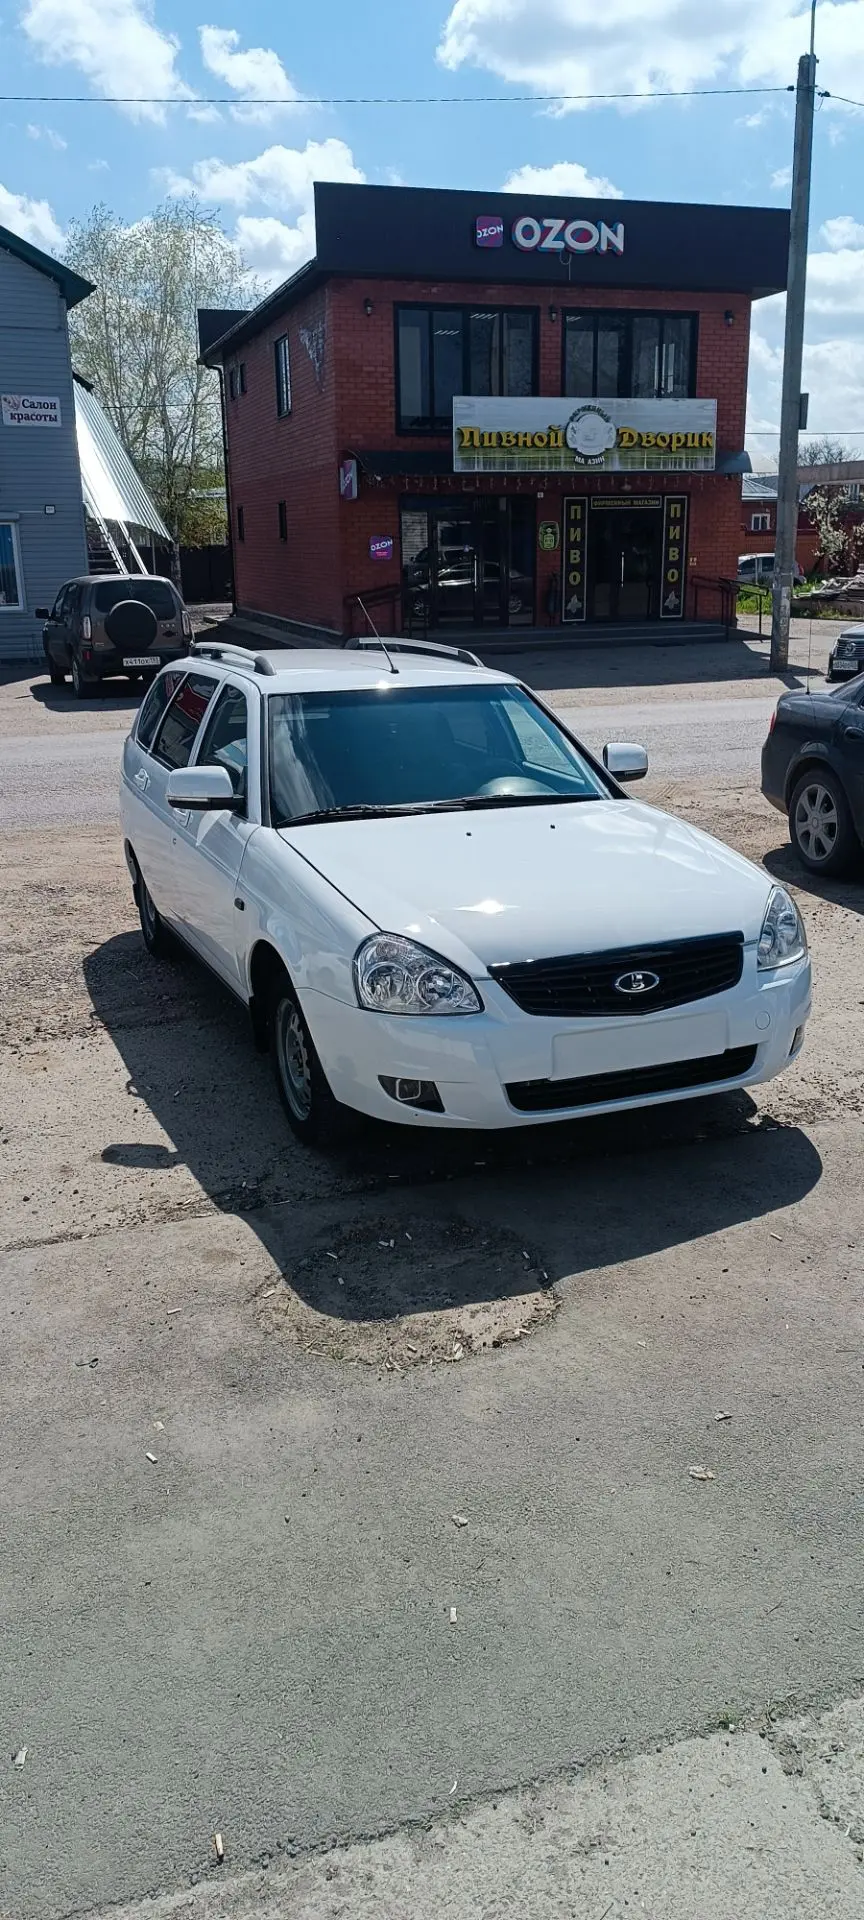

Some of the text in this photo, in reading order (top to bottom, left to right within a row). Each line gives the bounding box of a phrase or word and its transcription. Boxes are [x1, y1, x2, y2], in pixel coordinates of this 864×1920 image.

[513, 216, 624, 254] OZON
[21, 398, 57, 410] Салон
[10, 412, 58, 424] красоты
[459, 425, 713, 452] Пивной Дворик
[370, 539, 393, 551] OZON
[568, 505, 582, 586] ПИВО
[667, 503, 681, 583] ПИВО
